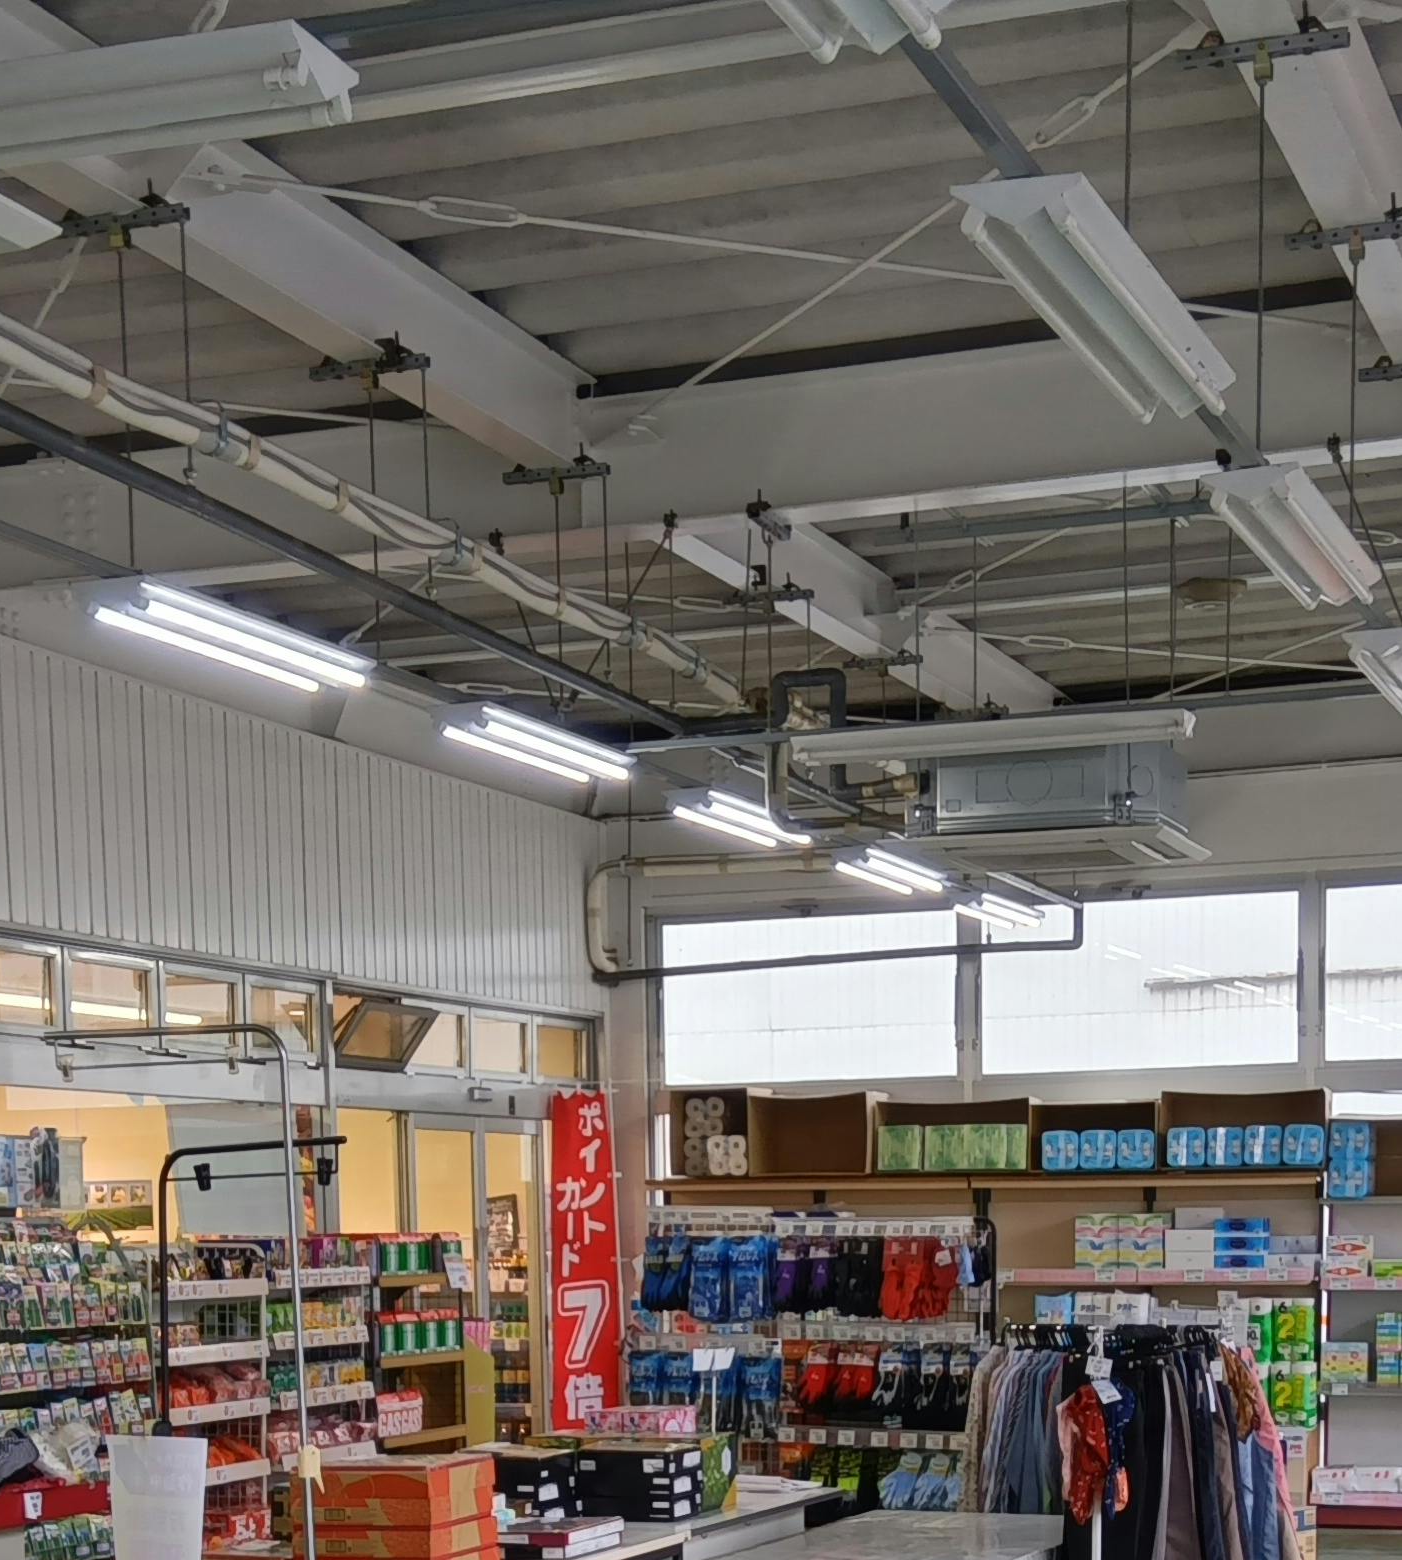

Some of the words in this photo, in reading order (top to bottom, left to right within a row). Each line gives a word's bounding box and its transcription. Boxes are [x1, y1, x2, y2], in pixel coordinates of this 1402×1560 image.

[556, 1175, 587, 1278] カード
[578, 1100, 607, 1246] ポイント
